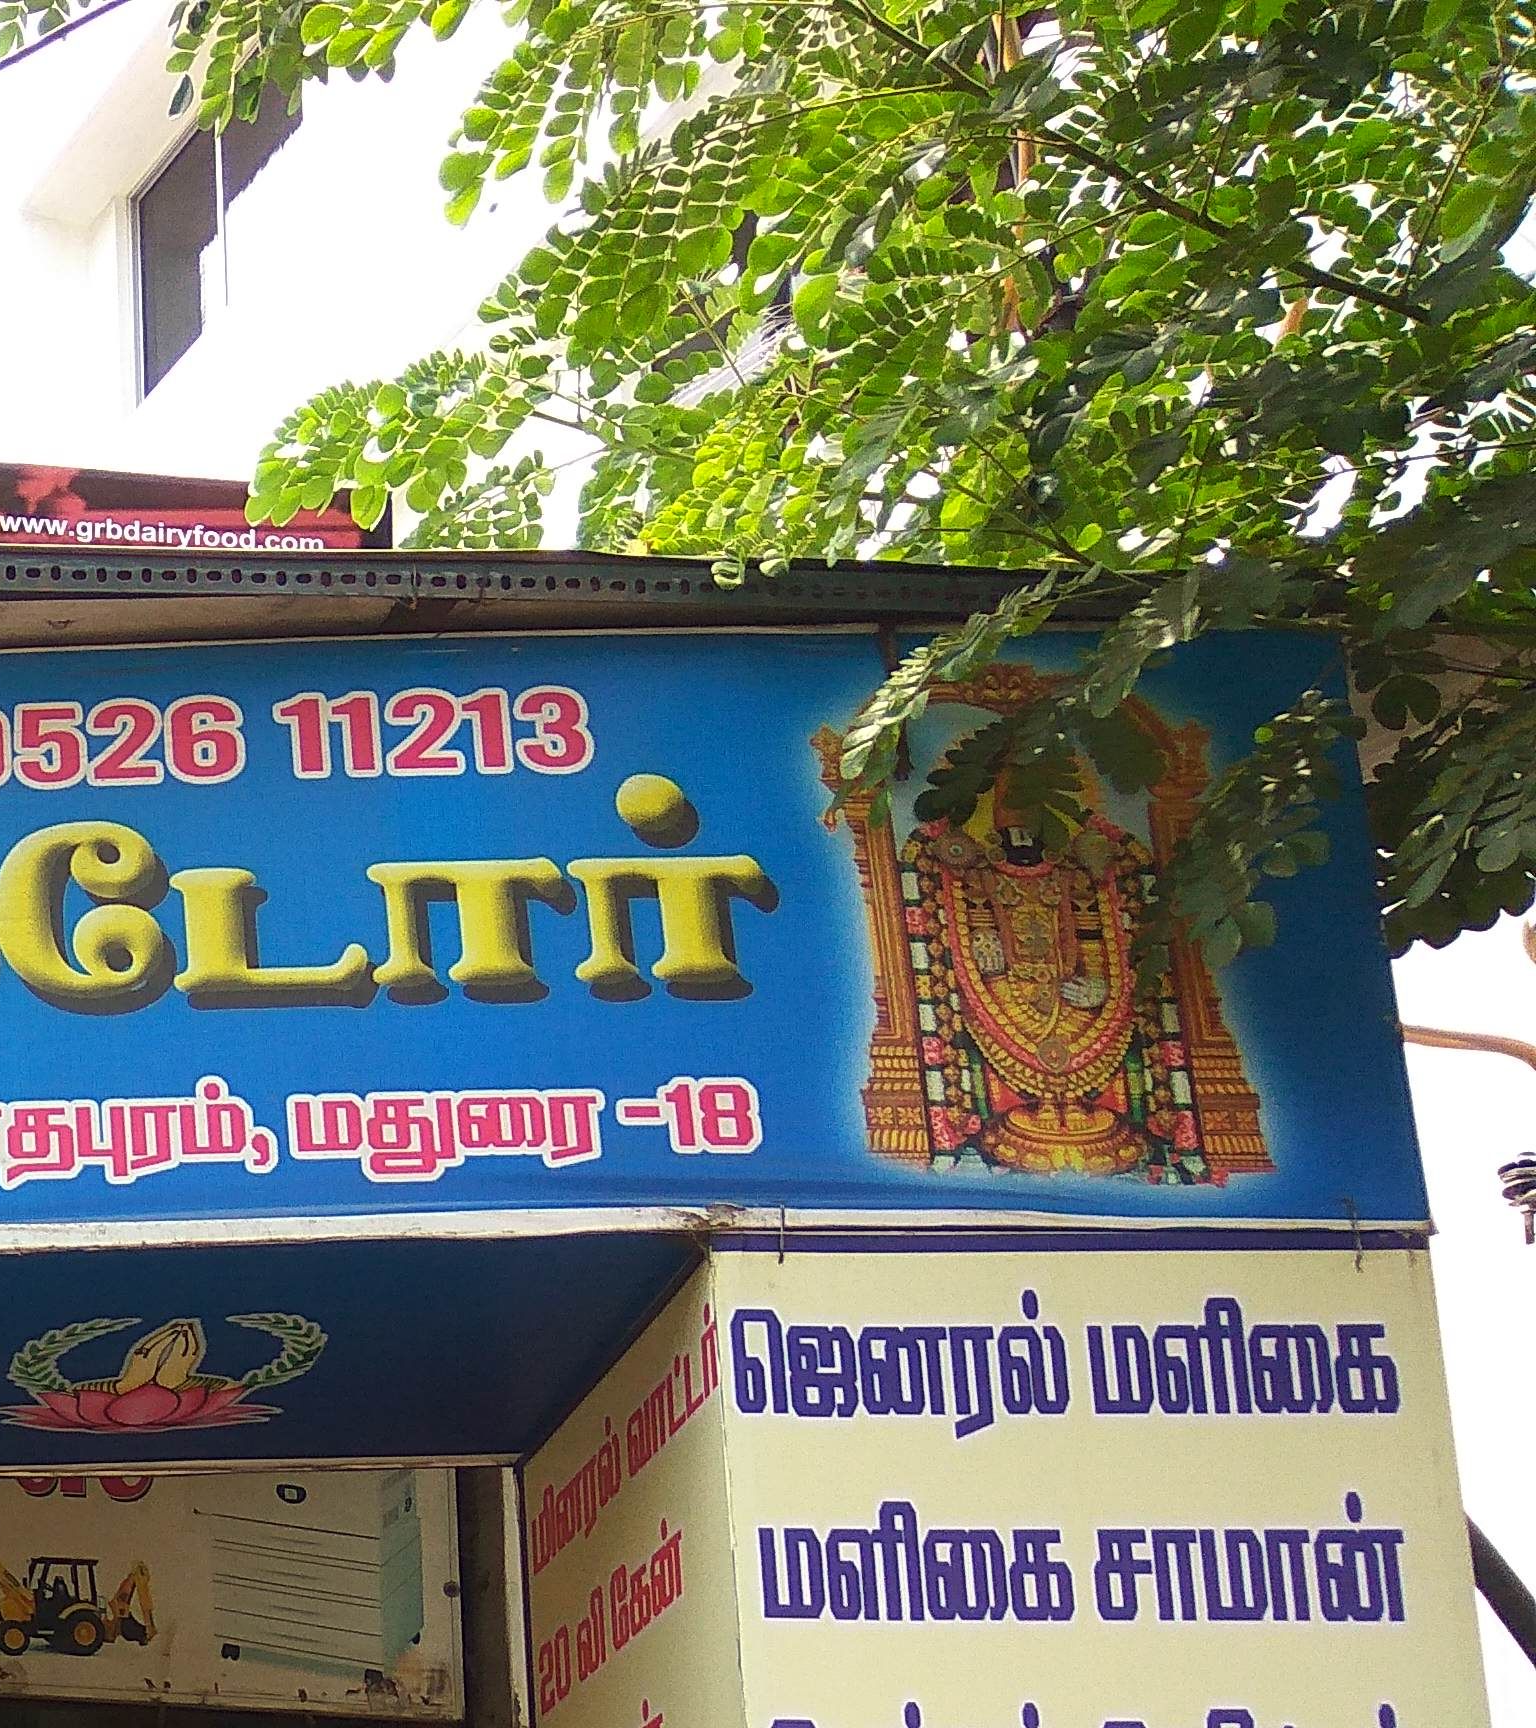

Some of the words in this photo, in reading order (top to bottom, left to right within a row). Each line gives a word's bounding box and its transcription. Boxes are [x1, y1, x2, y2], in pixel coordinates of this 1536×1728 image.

[275, 687, 593, 780] 11213
[291, 1089, 605, 1181] மதுரை
[730, 1289, 1071, 1440] ஜெனரல்
[1086, 1296, 1401, 1415] மளிகை
[531, 1416, 621, 1576] மினரல்
[627, 1302, 719, 1479] வாட்டர்
[539, 1624, 572, 1716] 20
[610, 1518, 683, 1651] கேன்
[758, 1500, 1075, 1622] மளிகை
[1094, 1491, 1406, 1623] சாமான்
